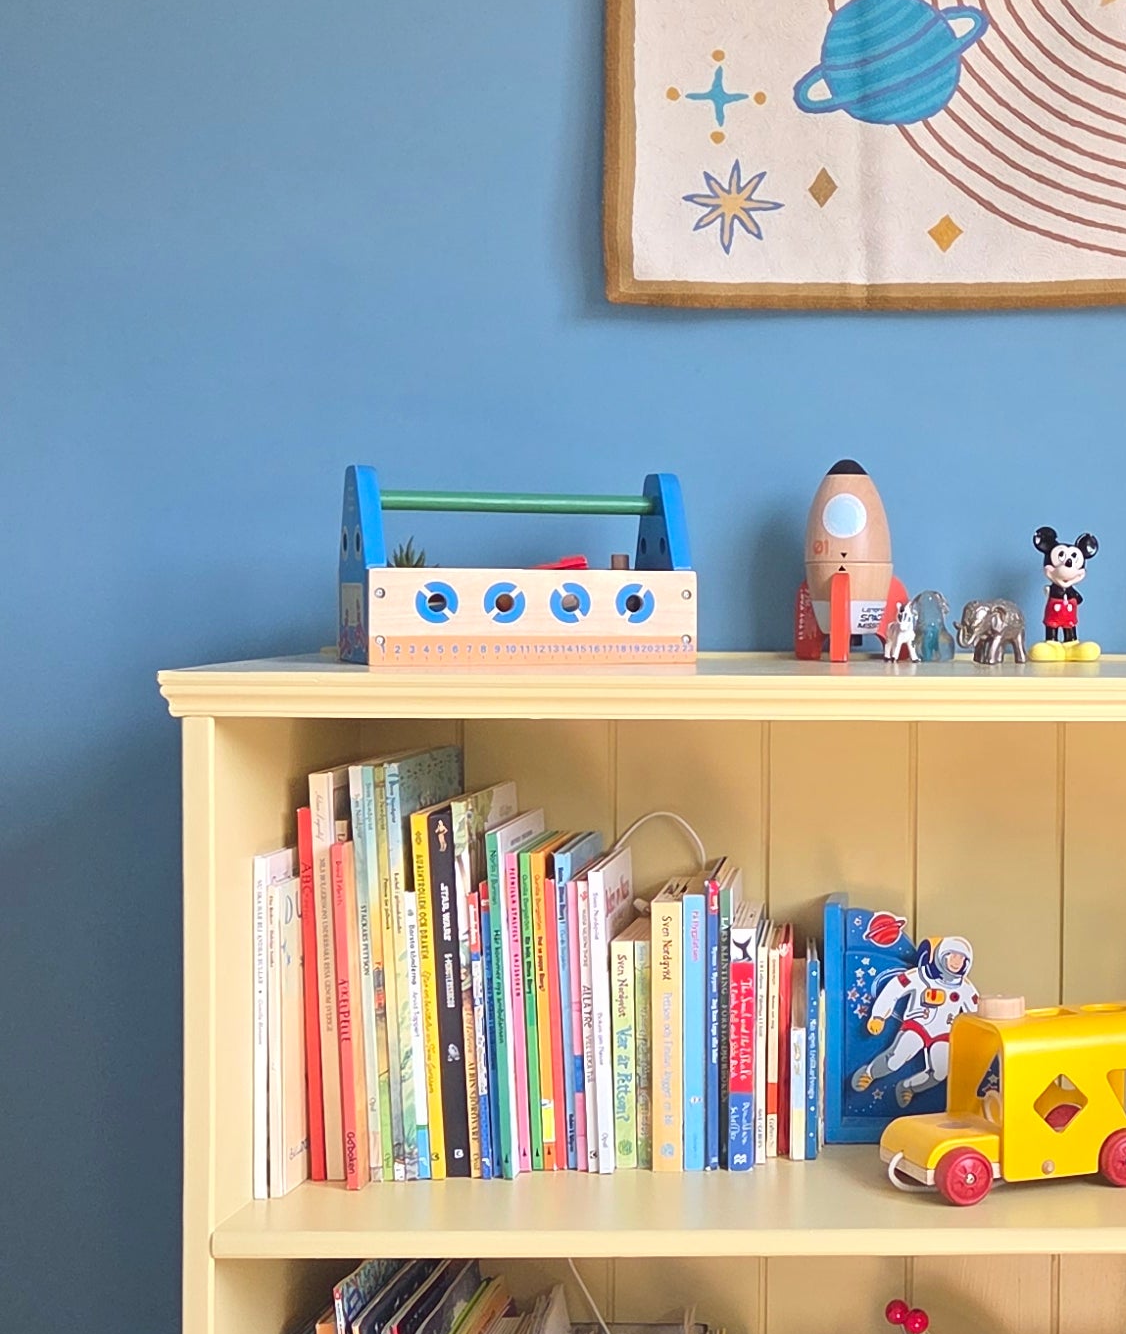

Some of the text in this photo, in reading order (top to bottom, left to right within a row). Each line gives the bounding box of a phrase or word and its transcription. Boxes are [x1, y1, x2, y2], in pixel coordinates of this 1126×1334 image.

[813, 540, 829, 555] 01
[394, 644, 401, 654] 2
[409, 644, 415, 654] 3
[423, 644, 430, 654] 4
[437, 644, 444, 654] 5
[452, 644, 458, 654] 6
[466, 644, 472, 654] 7
[480, 644, 486, 654] 8
[494, 644, 500, 654] 9
[506, 644, 516, 654] 10
[520, 644, 530, 654] 11
[534, 644, 545, 653] 12
[548, 644, 559, 653] 13
[561, 644, 573, 653] 14
[575, 644, 587, 653] 15
[589, 644, 600, 653] 16
[602, 644, 613, 653] 17
[616, 644, 627, 653] 18
[629, 644, 640, 653] 19
[641, 644, 653, 653] 20
[655, 644, 665, 653] 21
[668, 644, 679, 653] 22
[440, 882, 451, 912] STAR
[418, 912, 428, 929] OCH
[442, 912, 453, 942] WARS
[721, 916, 730, 943] LARS
[359, 904, 371, 976] STACKARS PETTSON
[659, 915, 673, 981] Sven Nordqvist
[721, 945, 729, 995] KLINTING
[493, 929, 506, 1044] Här kommer nya ambulansen
[582, 985, 593, 1009] ALLA
[615, 954, 630, 1018] Sven Nordqvist
[662, 991, 673, 1021] Pettson
[663, 1023, 673, 1038] och
[740, 977, 753, 1081] The Snail and the Whale
[663, 1040, 674, 1068] Findus
[616, 1025, 636, 1122] Var är Pettson?
